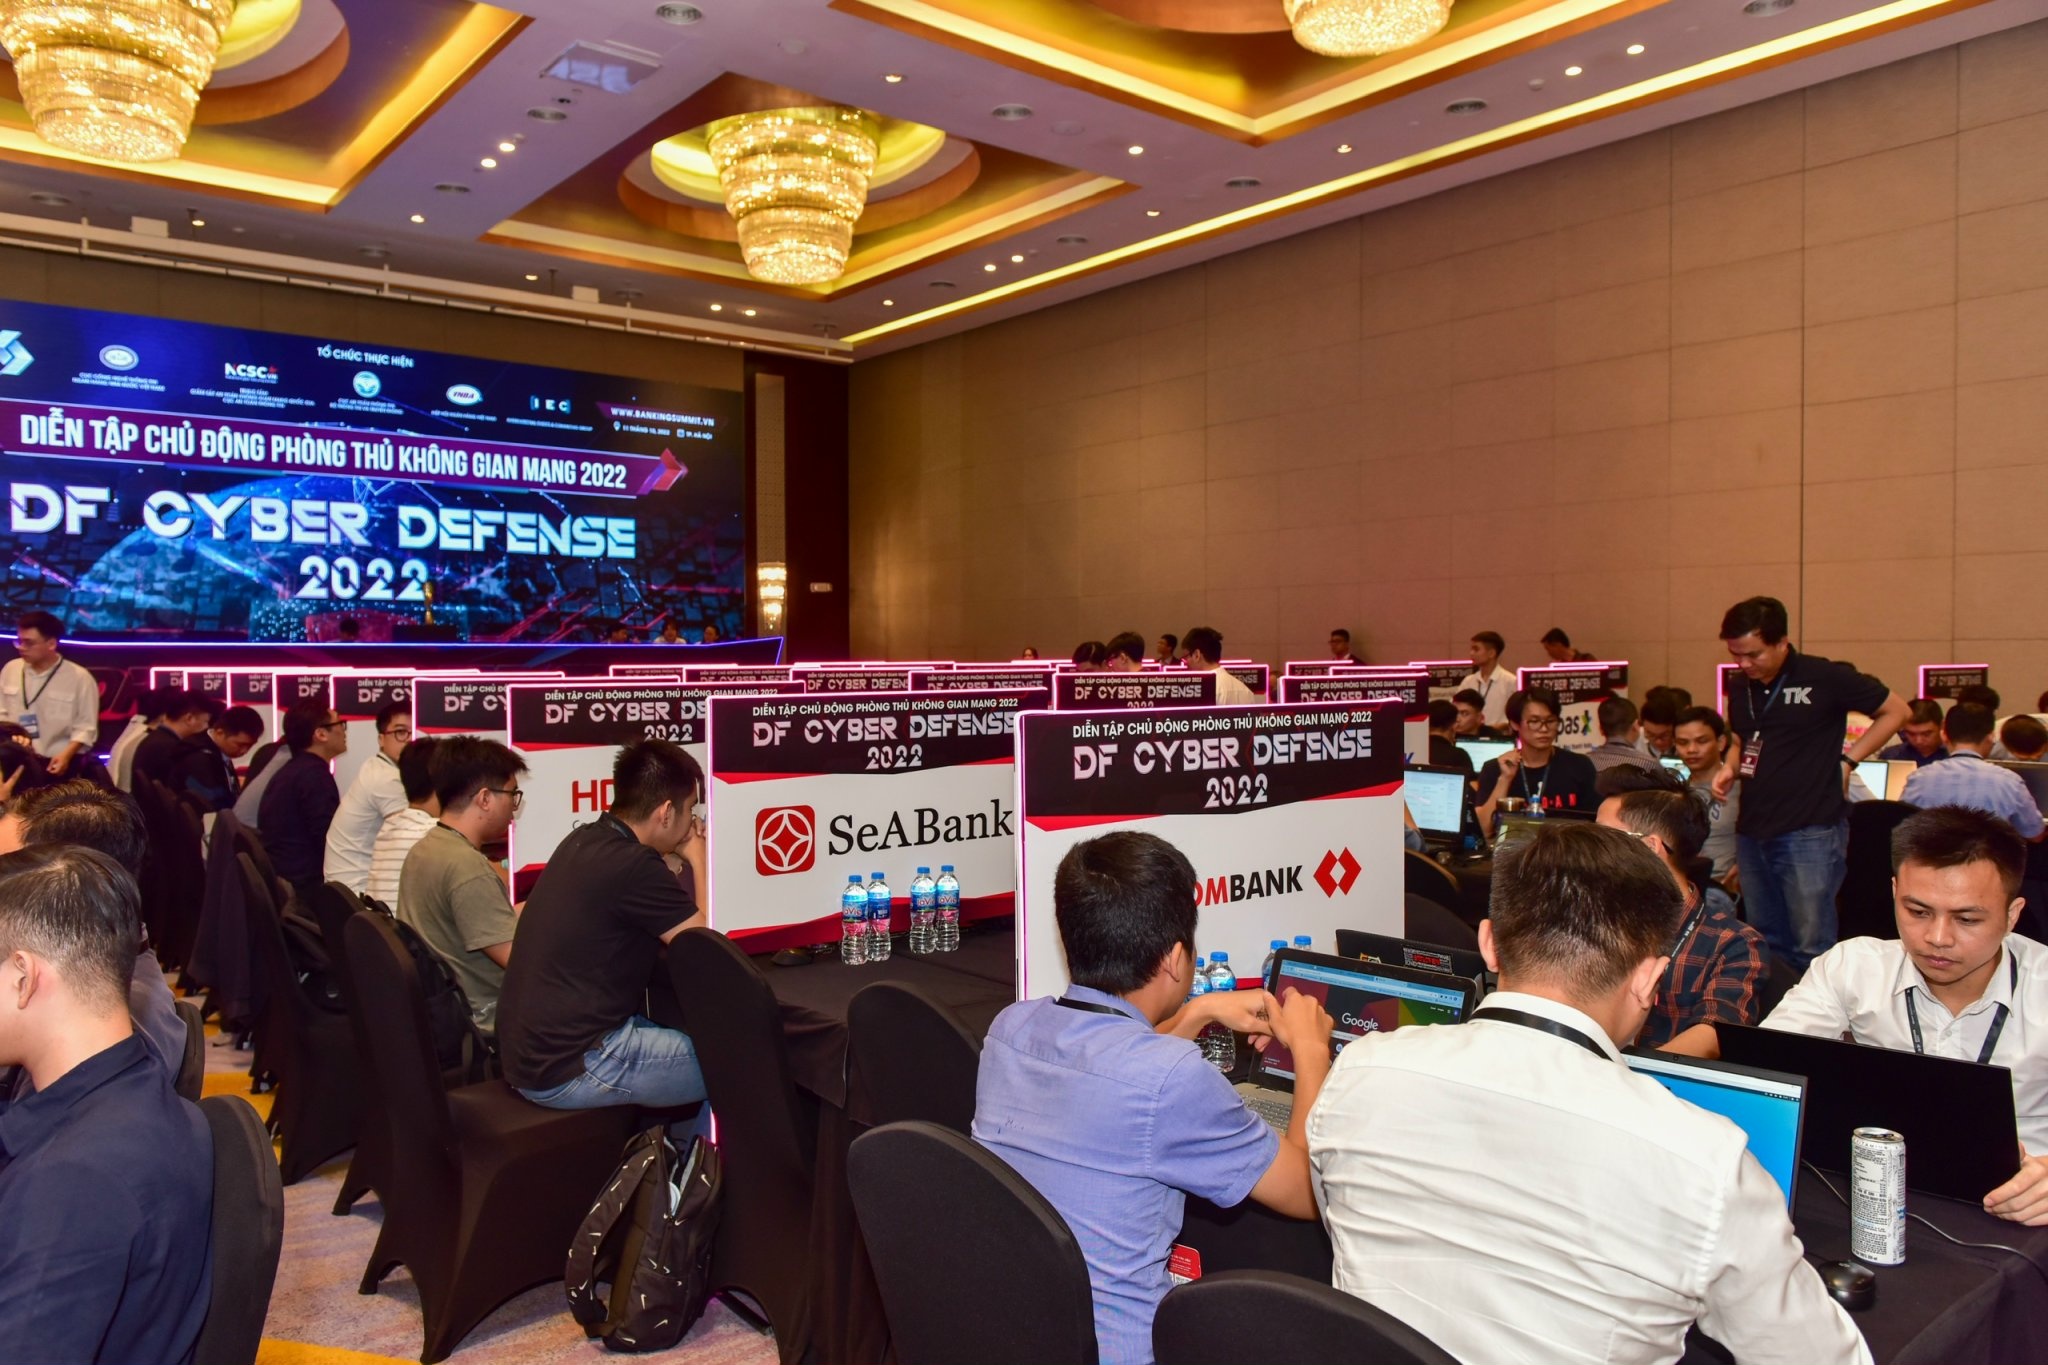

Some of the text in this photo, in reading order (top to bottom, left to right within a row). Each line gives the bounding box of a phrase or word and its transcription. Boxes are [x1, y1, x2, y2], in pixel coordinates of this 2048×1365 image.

[611, 407, 715, 426] WWW.BANKINGSUMMIT.VN
[20, 407, 627, 489] DIỄN TẬP CHỦ ĐỘNG PHÒNG THỦ KHÔNG GIAN MẠNG 2022
[10, 482, 636, 559] DF CYBER DEFENSE
[295, 555, 429, 600] 2022
[204, 680, 222, 690] DF
[249, 681, 269, 692] DF
[299, 685, 320, 697] DF
[444, 683, 461, 693] DIỄN
[463, 684, 477, 694] TẬP
[479, 684, 496, 692] CHỦ
[808, 678, 908, 690] DF CYBER DEFEN
[1075, 685, 1201, 699] DF CYBER DEFENSE
[358, 689, 383, 702] DF
[445, 695, 473, 712] DF
[545, 690, 565, 700] DIỄN
[567, 690, 583, 702] TẬP
[585, 689, 603, 699] CHỦ
[606, 689, 631, 701] ĐỘNG
[634, 689, 663, 698] PHÒNG
[666, 688, 680, 697] THỦ
[683, 688, 711, 697] KHÔNG
[546, 704, 578, 724] DF
[589, 701, 671, 722] CYBER
[753, 698, 1018, 718] DIỄN TẬP CHỦ ĐỘNG PHÒNG THỦ KHÔNG GIAN MẠNG 2022
[644, 723, 693, 742] 2022
[753, 711, 1016, 747] DF CYBER DEFENSE
[1073, 711, 1372, 739] DIỄN TẬP CHỦ ĐỘNG PHÒNG THỦ KHÔNG GIAN MẠNG 2022
[865, 744, 923, 770] 2022
[1074, 728, 1372, 780] DF CYBER DEFENSE
[1204, 773, 1268, 809] 2022
[828, 798, 1015, 856] SeABank
[1341, 1012, 1379, 1032] Google
